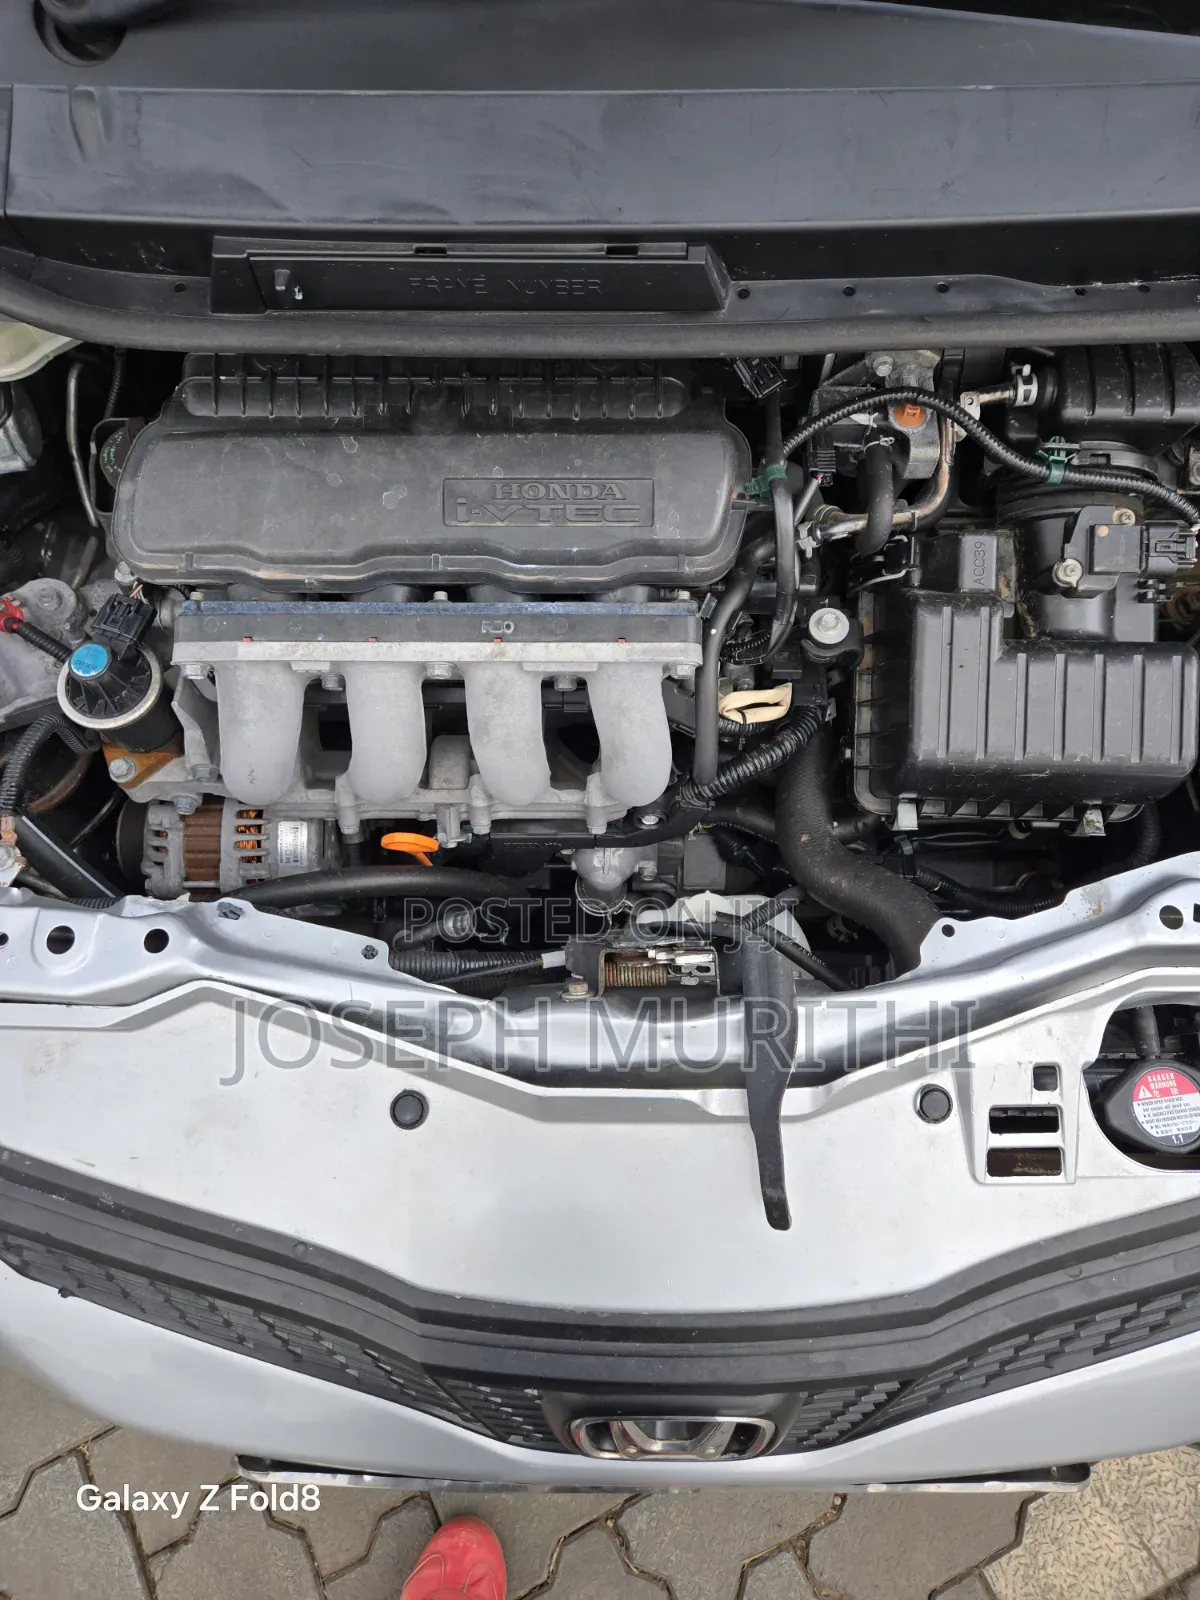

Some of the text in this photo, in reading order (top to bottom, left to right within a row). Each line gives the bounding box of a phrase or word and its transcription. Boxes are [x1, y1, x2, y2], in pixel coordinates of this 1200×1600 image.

[408, 276, 602, 296] FRAME NUMBER
[492, 482, 627, 501] HONDA
[455, 497, 641, 523] i-VTEC
[972, 541, 987, 586] ACC39
[1147, 1072, 1175, 1082] DANGER
[1150, 1079, 1177, 1090] WARNING
[1172, 1134, 1184, 1144] 1.1
